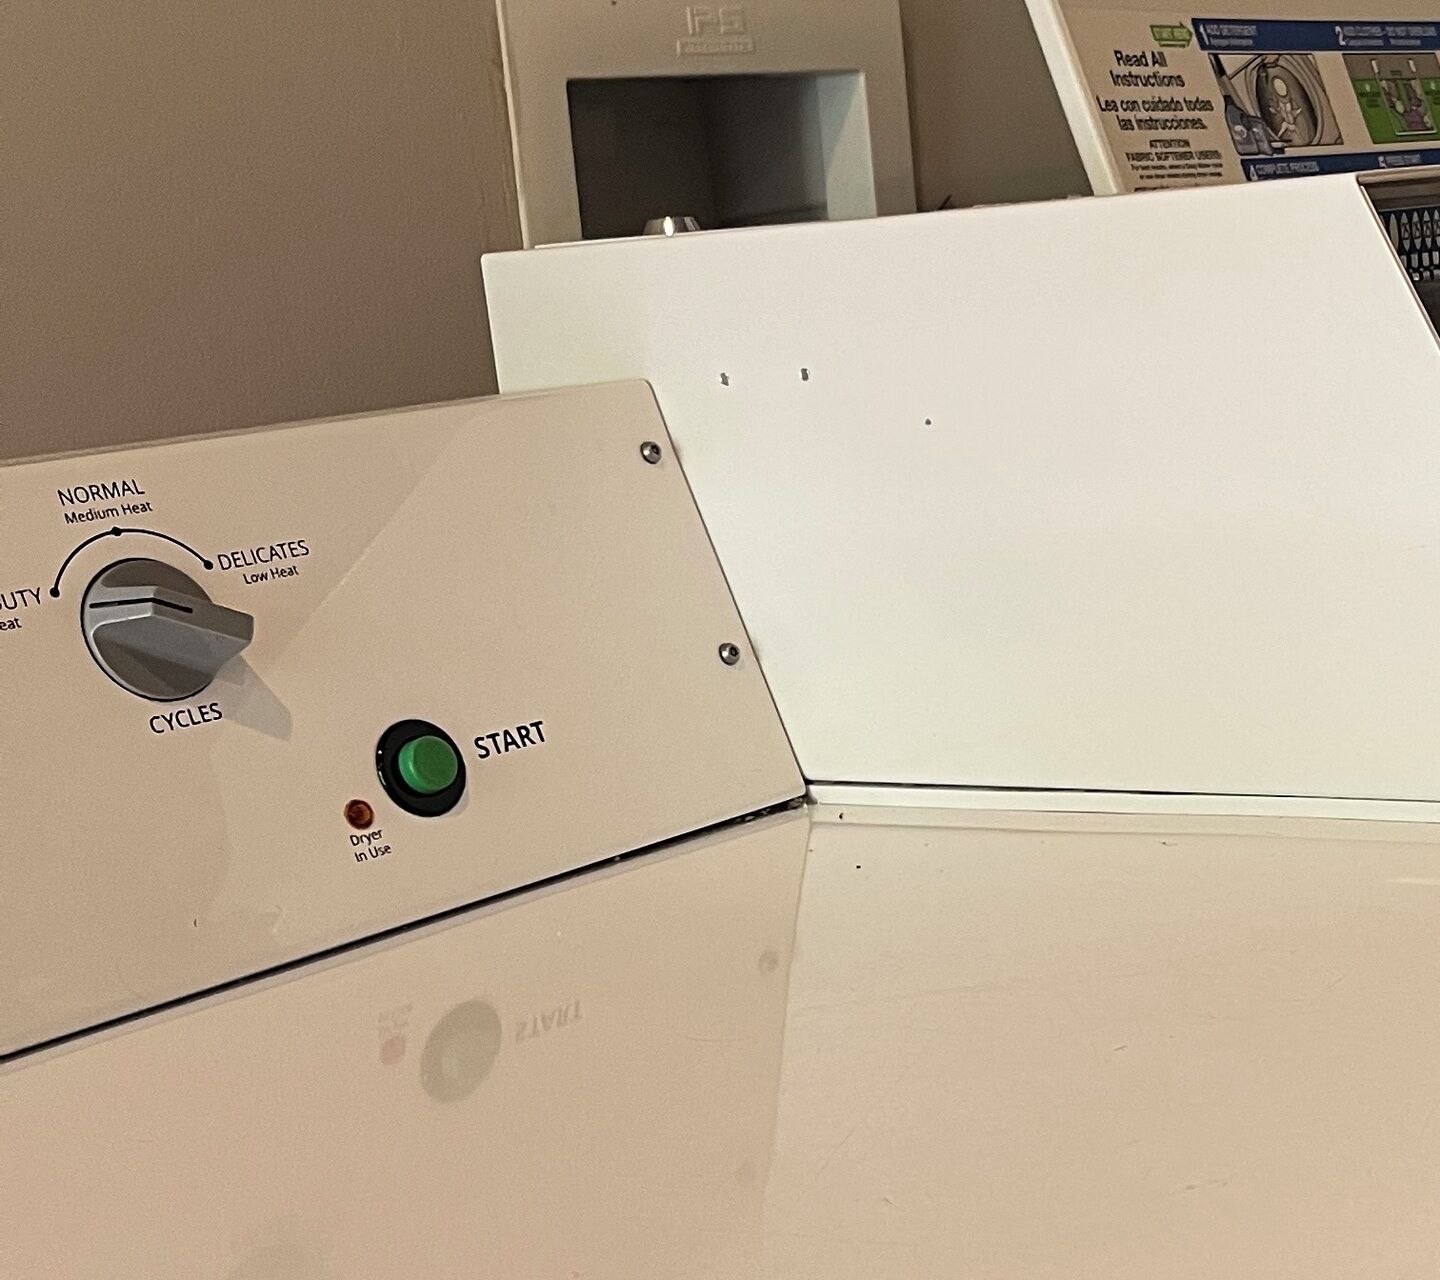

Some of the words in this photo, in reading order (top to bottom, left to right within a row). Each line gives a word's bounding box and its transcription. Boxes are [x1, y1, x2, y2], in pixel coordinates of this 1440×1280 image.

[1114, 50, 1149, 67] Read
[1151, 51, 1168, 67] All
[1109, 70, 1185, 88] Instructions
[1096, 95, 1119, 112] Lea
[1120, 99, 1140, 112] con
[1142, 96, 1184, 112] cuidado
[1183, 96, 1214, 111] todas
[1116, 114, 1135, 131] las
[57, 479, 145, 506] NORMAL
[64, 507, 120, 524] Medium
[121, 501, 153, 516] Heat
[217, 540, 310, 571] DELICATES
[243, 571, 269, 584] Low
[268, 565, 299, 579] Heat
[0, 587, 41, 610] UTY
[0, 617, 22, 631] eat
[149, 702, 223, 734] CYCLES
[474, 720, 546, 759] START
[350, 829, 383, 847] Dryer
[354, 851, 368, 863] In
[369, 844, 392, 859] Use
